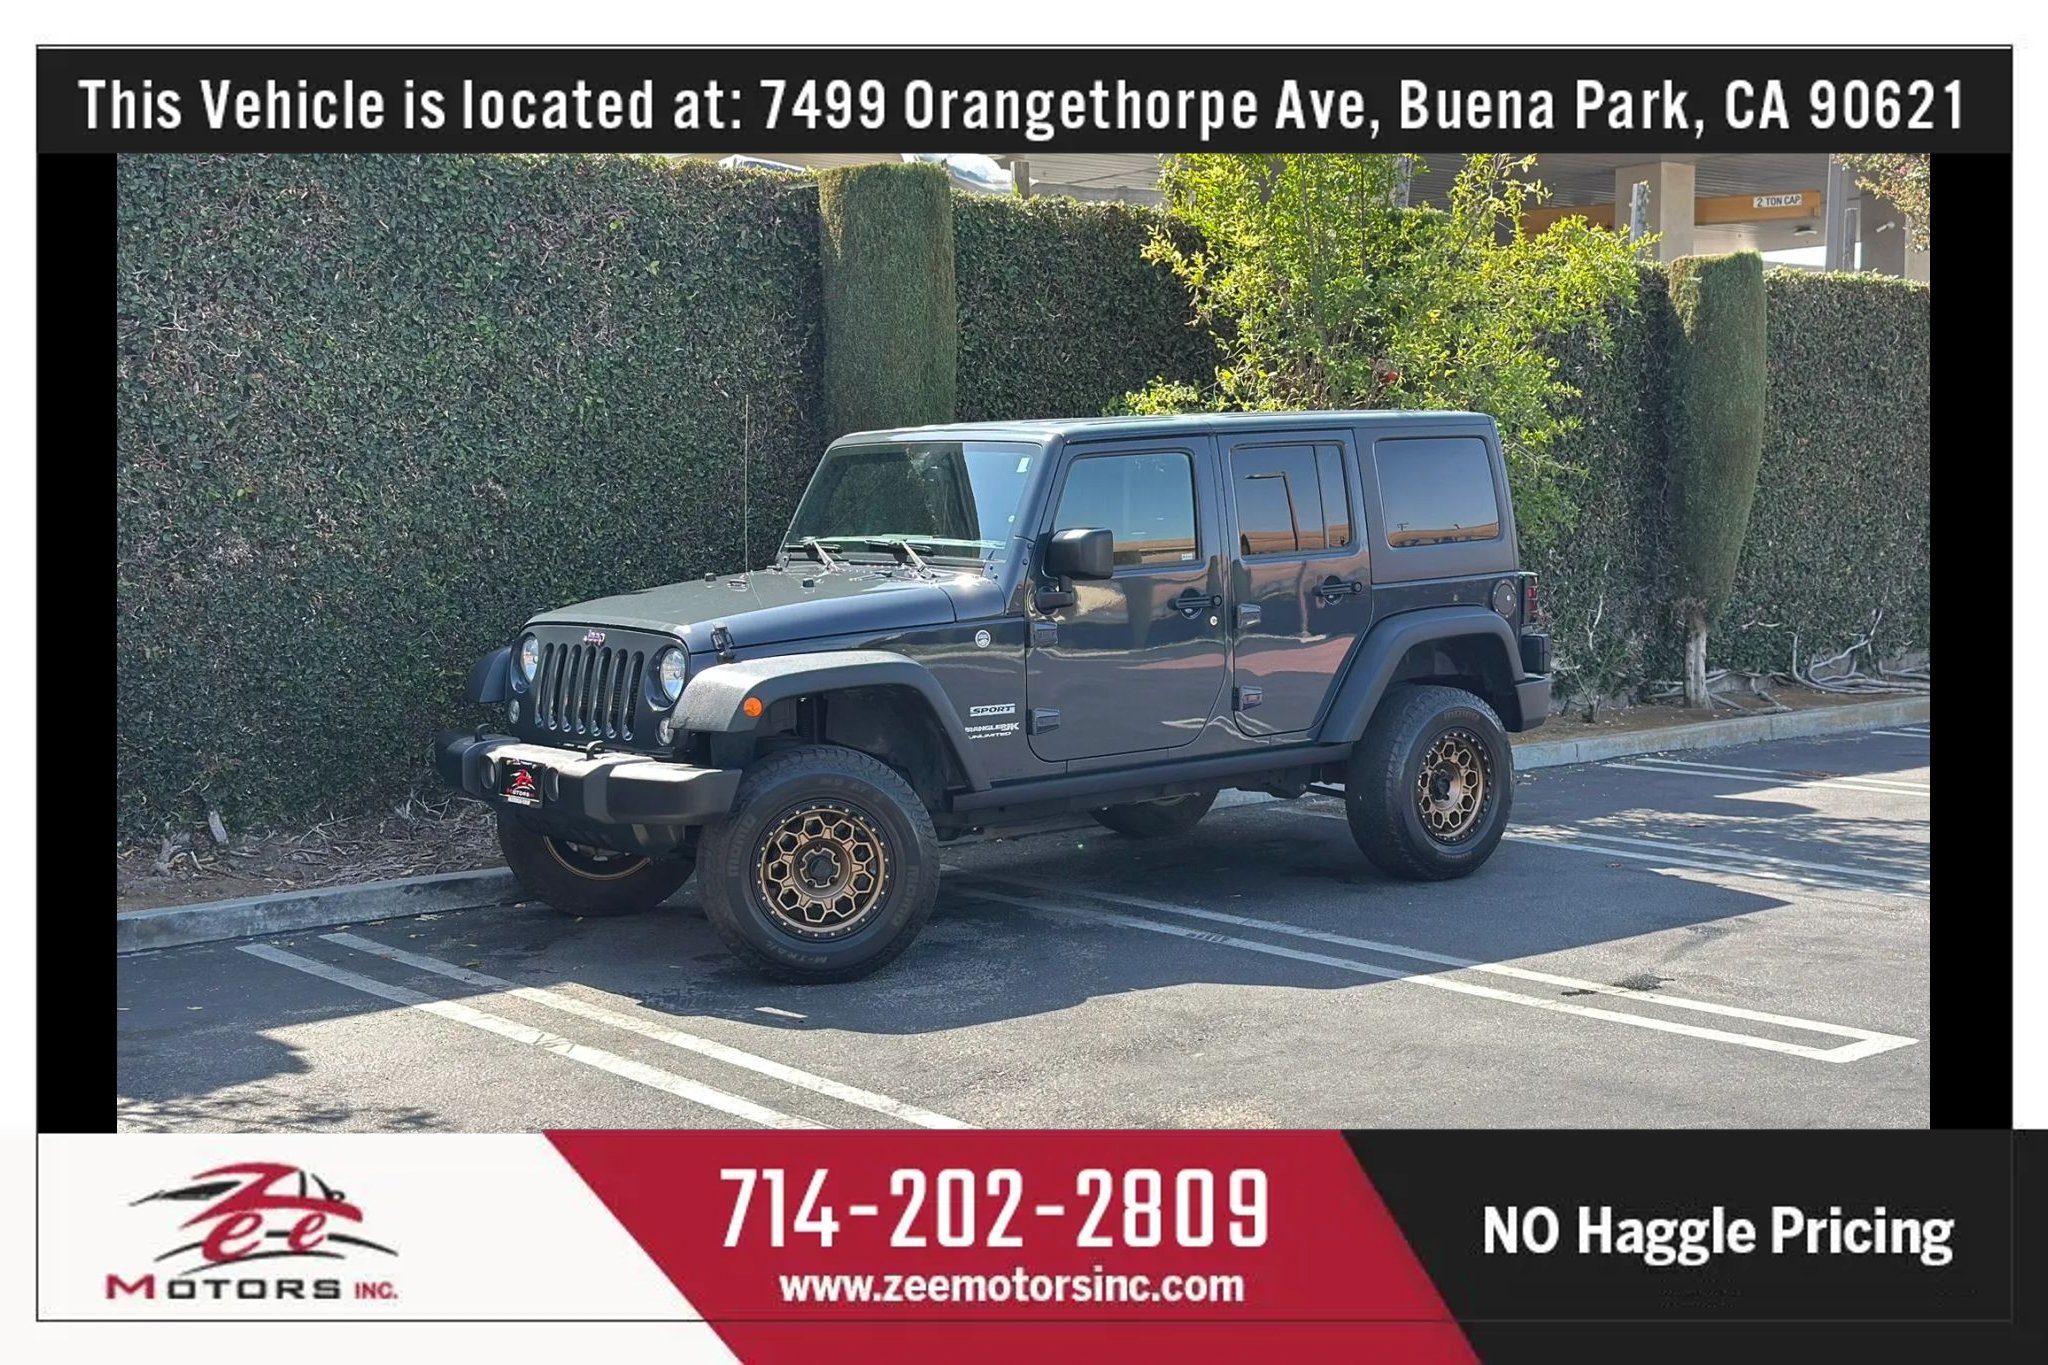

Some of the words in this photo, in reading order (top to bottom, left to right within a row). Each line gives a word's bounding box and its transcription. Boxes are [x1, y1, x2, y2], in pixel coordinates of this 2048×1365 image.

[1756, 197, 1763, 207] 2
[1766, 197, 1782, 205] TON
[1784, 195, 1800, 204] CAP
[968, 731, 1012, 739] UNLIMITED
